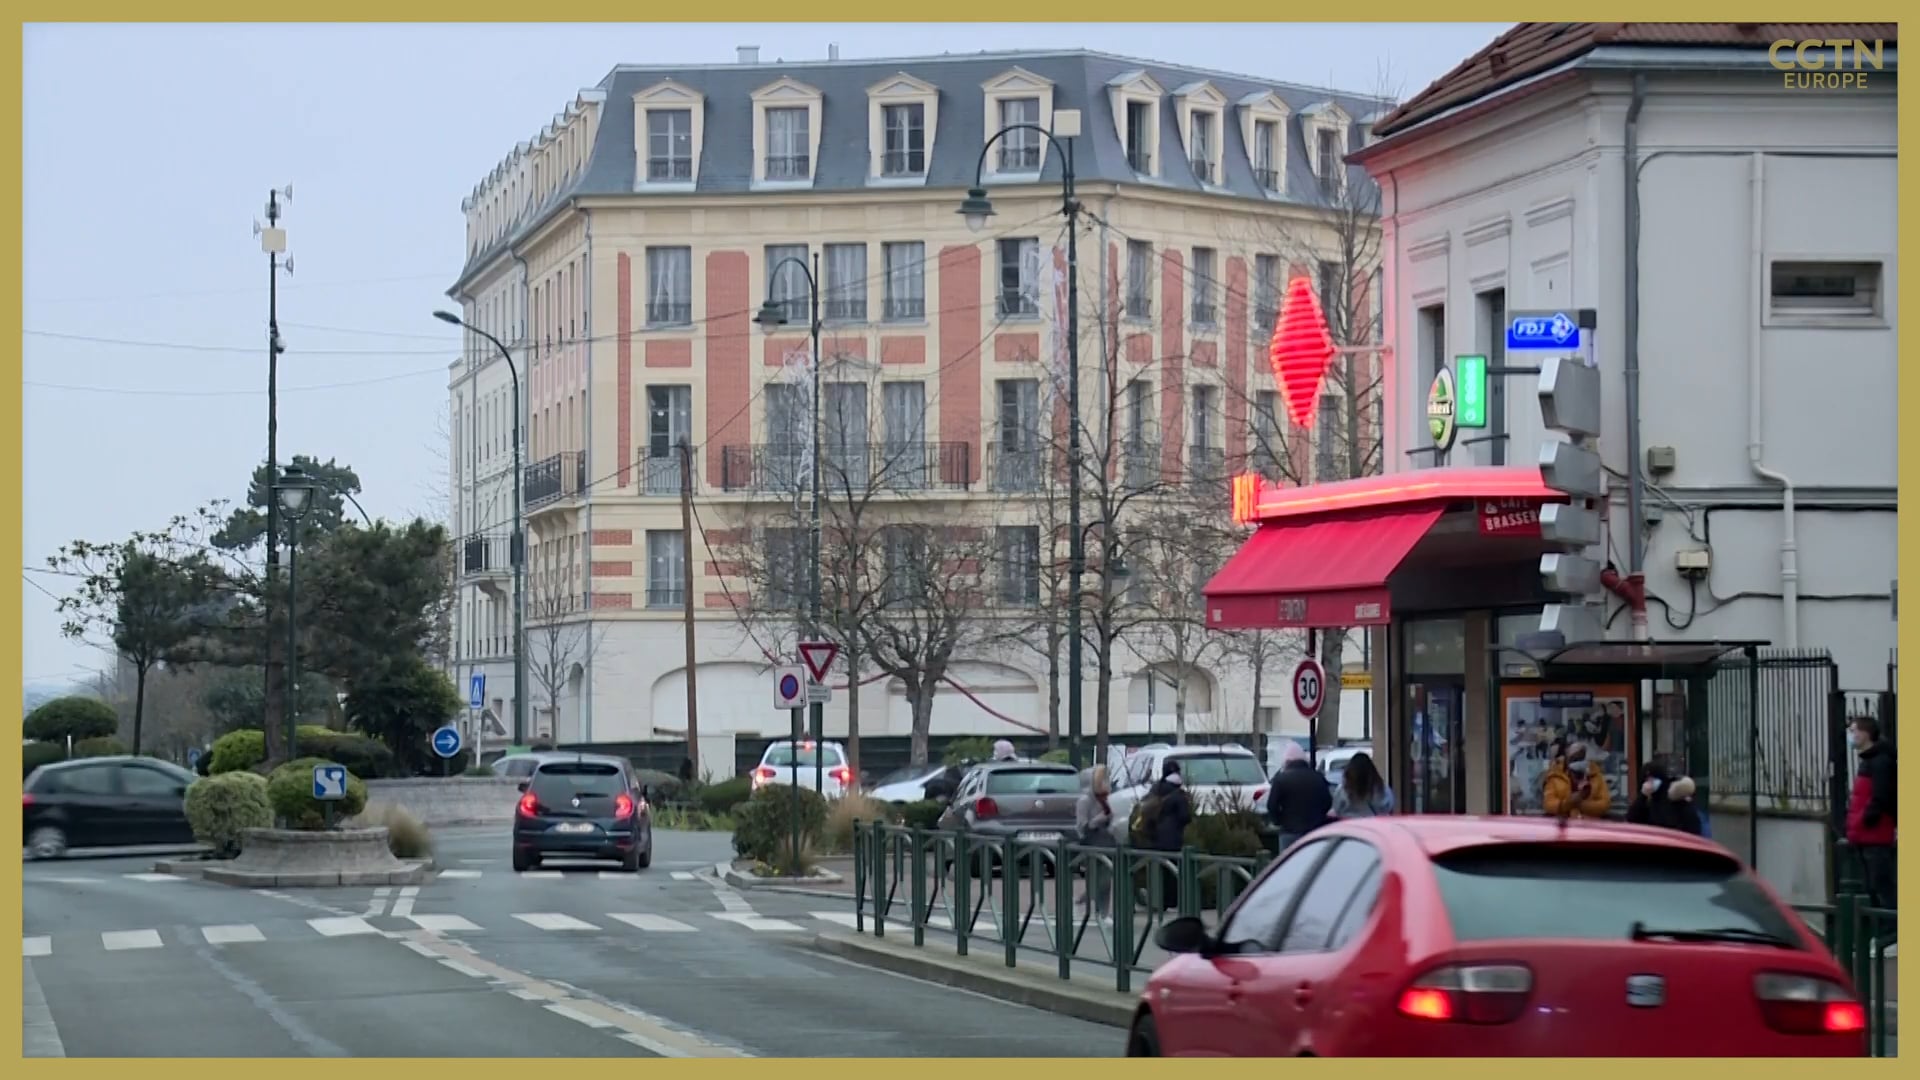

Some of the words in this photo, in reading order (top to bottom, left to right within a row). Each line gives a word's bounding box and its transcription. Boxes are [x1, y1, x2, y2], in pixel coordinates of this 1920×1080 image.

[1517, 321, 1546, 335] FDJ
[1485, 510, 1540, 531] BRASSER
[1300, 677, 1318, 700] 30
